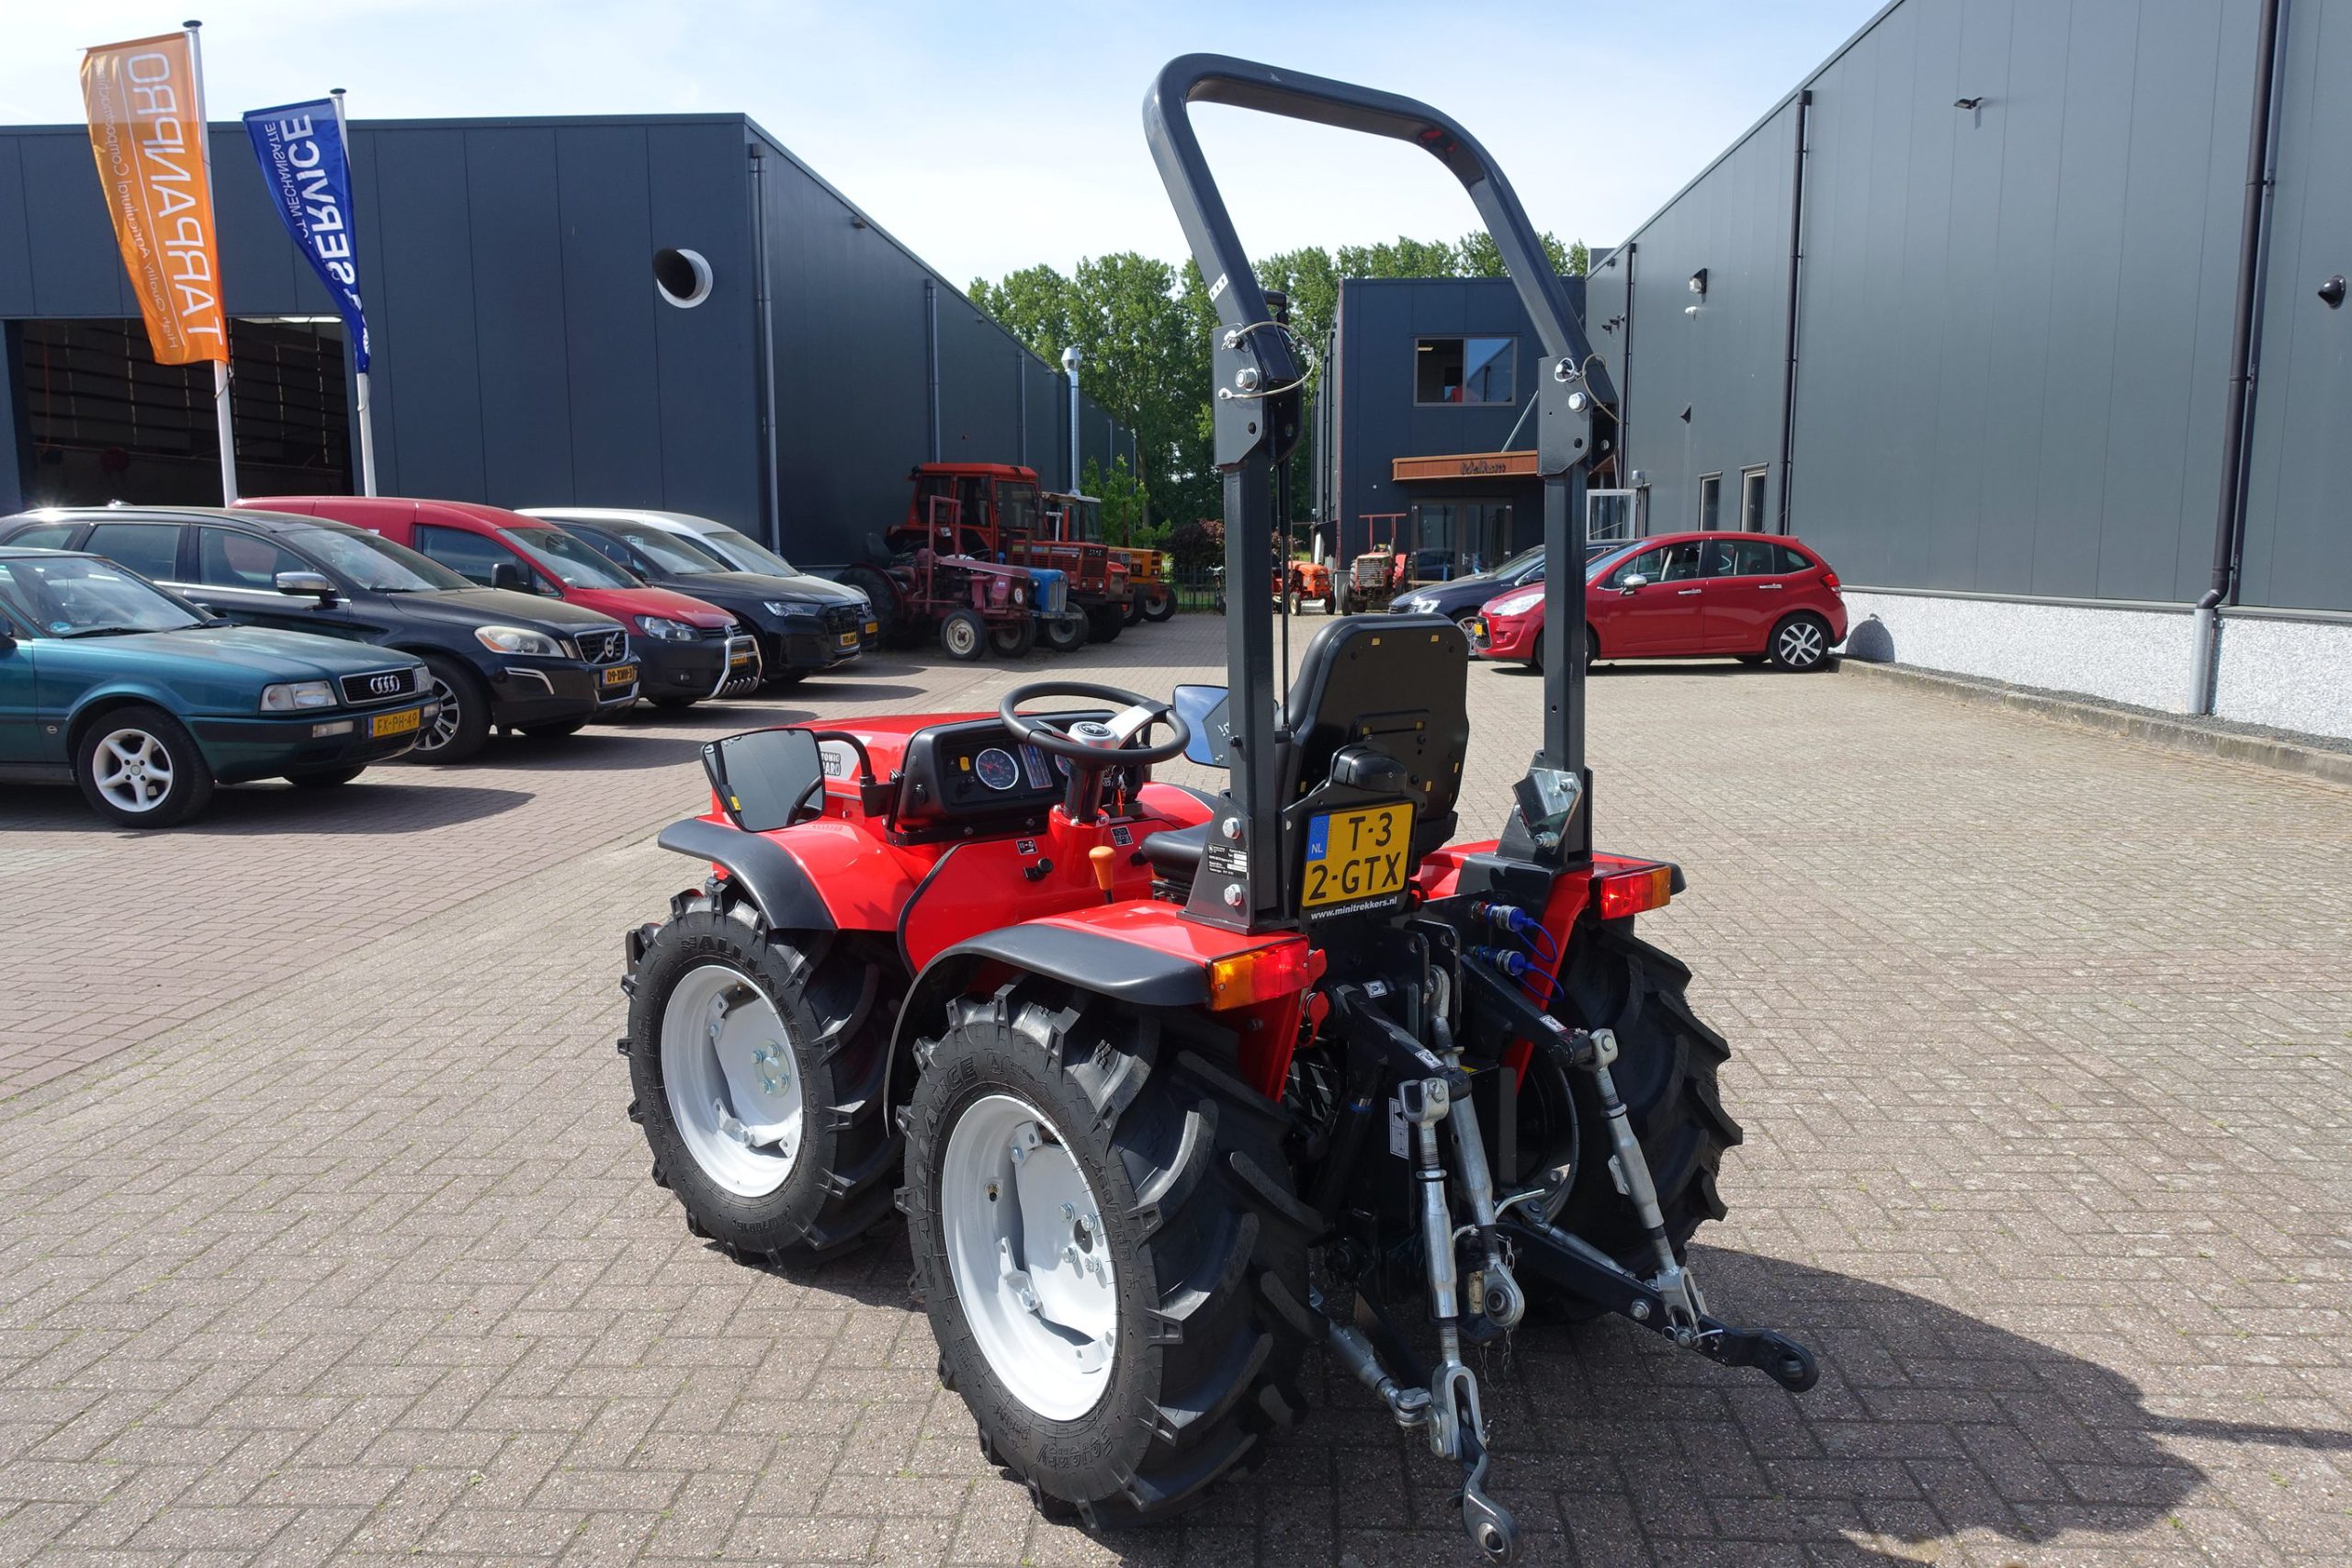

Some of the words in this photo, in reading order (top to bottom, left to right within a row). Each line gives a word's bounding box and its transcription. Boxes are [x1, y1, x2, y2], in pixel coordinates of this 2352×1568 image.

[1349, 811, 1393, 852] T-3
[1311, 842, 1324, 854] NL
[1308, 852, 1401, 901] 2-GTX
[1311, 897, 1397, 920] www.minitrekkers.nl
